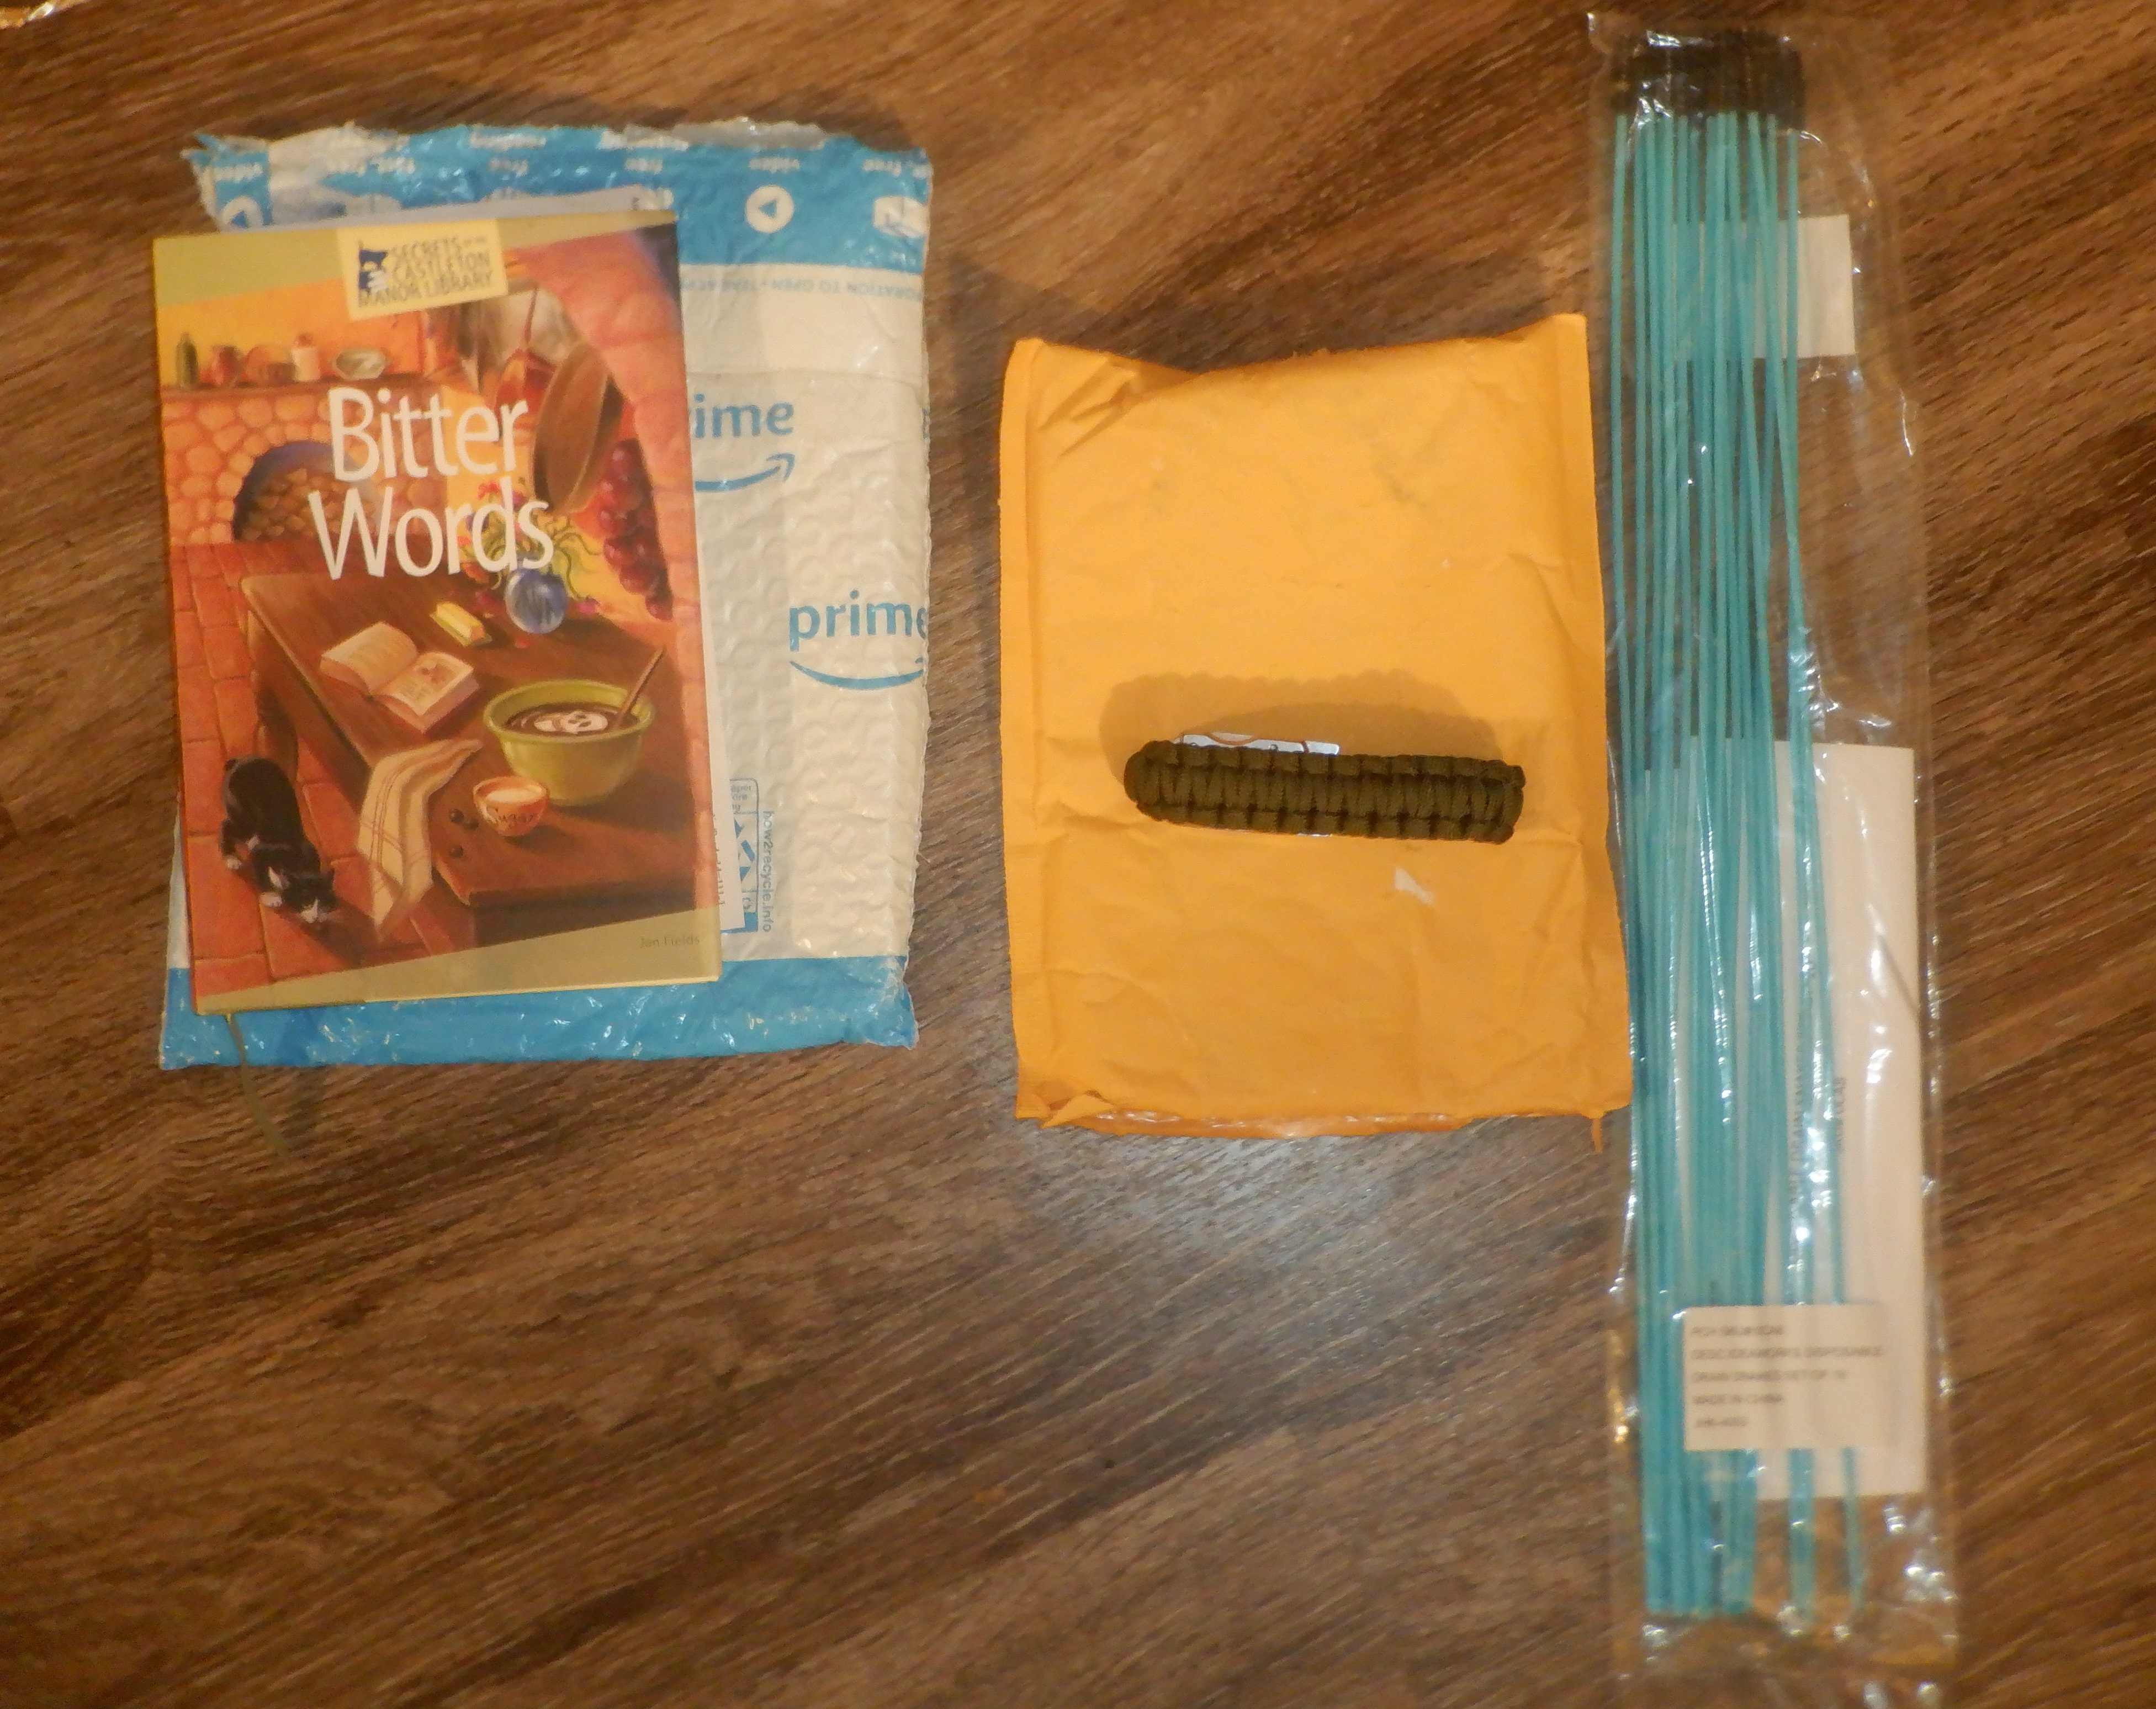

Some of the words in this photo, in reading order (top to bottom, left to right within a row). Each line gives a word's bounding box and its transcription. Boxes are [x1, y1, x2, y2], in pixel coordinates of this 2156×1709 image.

[390, 235, 462, 261] SECRETS
[393, 250, 491, 282] CASTLETON
[358, 281, 422, 308] MANOR
[425, 269, 493, 297] LIBRARY
[329, 386, 529, 482] Bitter
[694, 394, 795, 439] ime
[307, 476, 554, 580] Words
[760, 810, 775, 933] how2recycle.info
[664, 934, 700, 946] Fields
